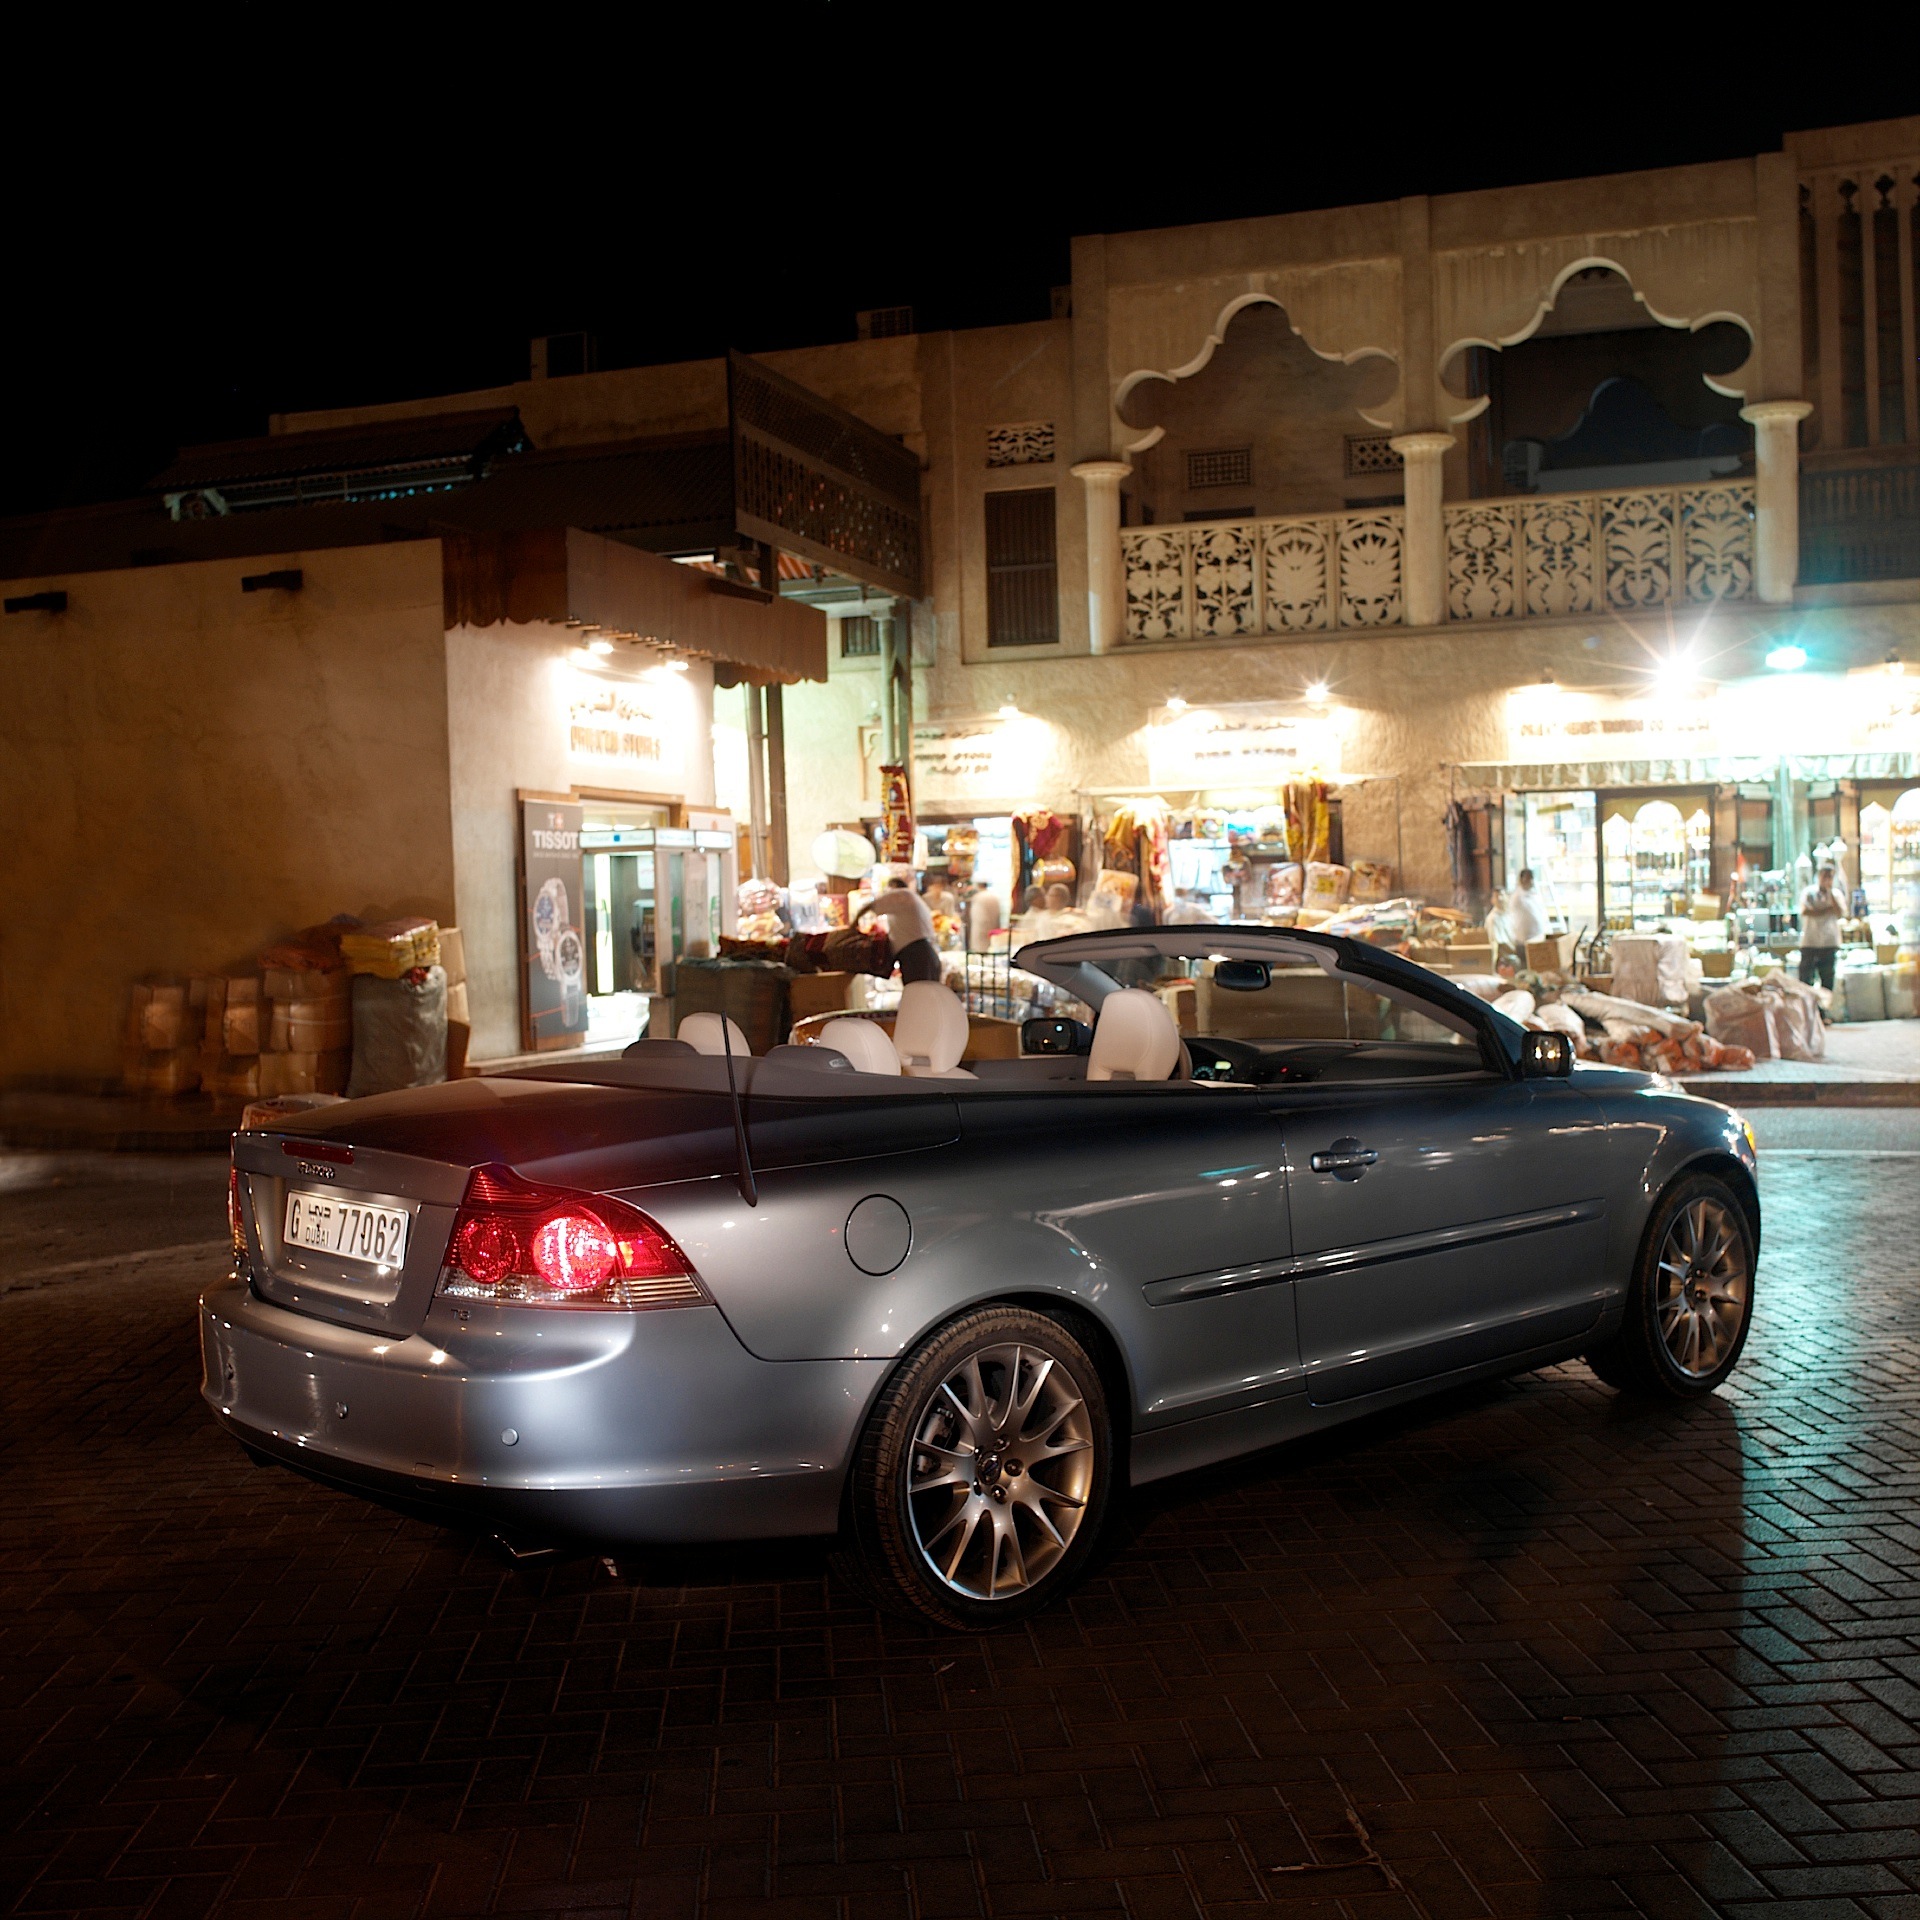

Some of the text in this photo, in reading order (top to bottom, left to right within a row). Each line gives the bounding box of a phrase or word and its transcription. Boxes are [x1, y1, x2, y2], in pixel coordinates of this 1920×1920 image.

[532, 829, 579, 850] TISSOT
[291, 1198, 302, 1240] G
[305, 1226, 331, 1247] DUBAI
[337, 1208, 401, 1262] 77062
